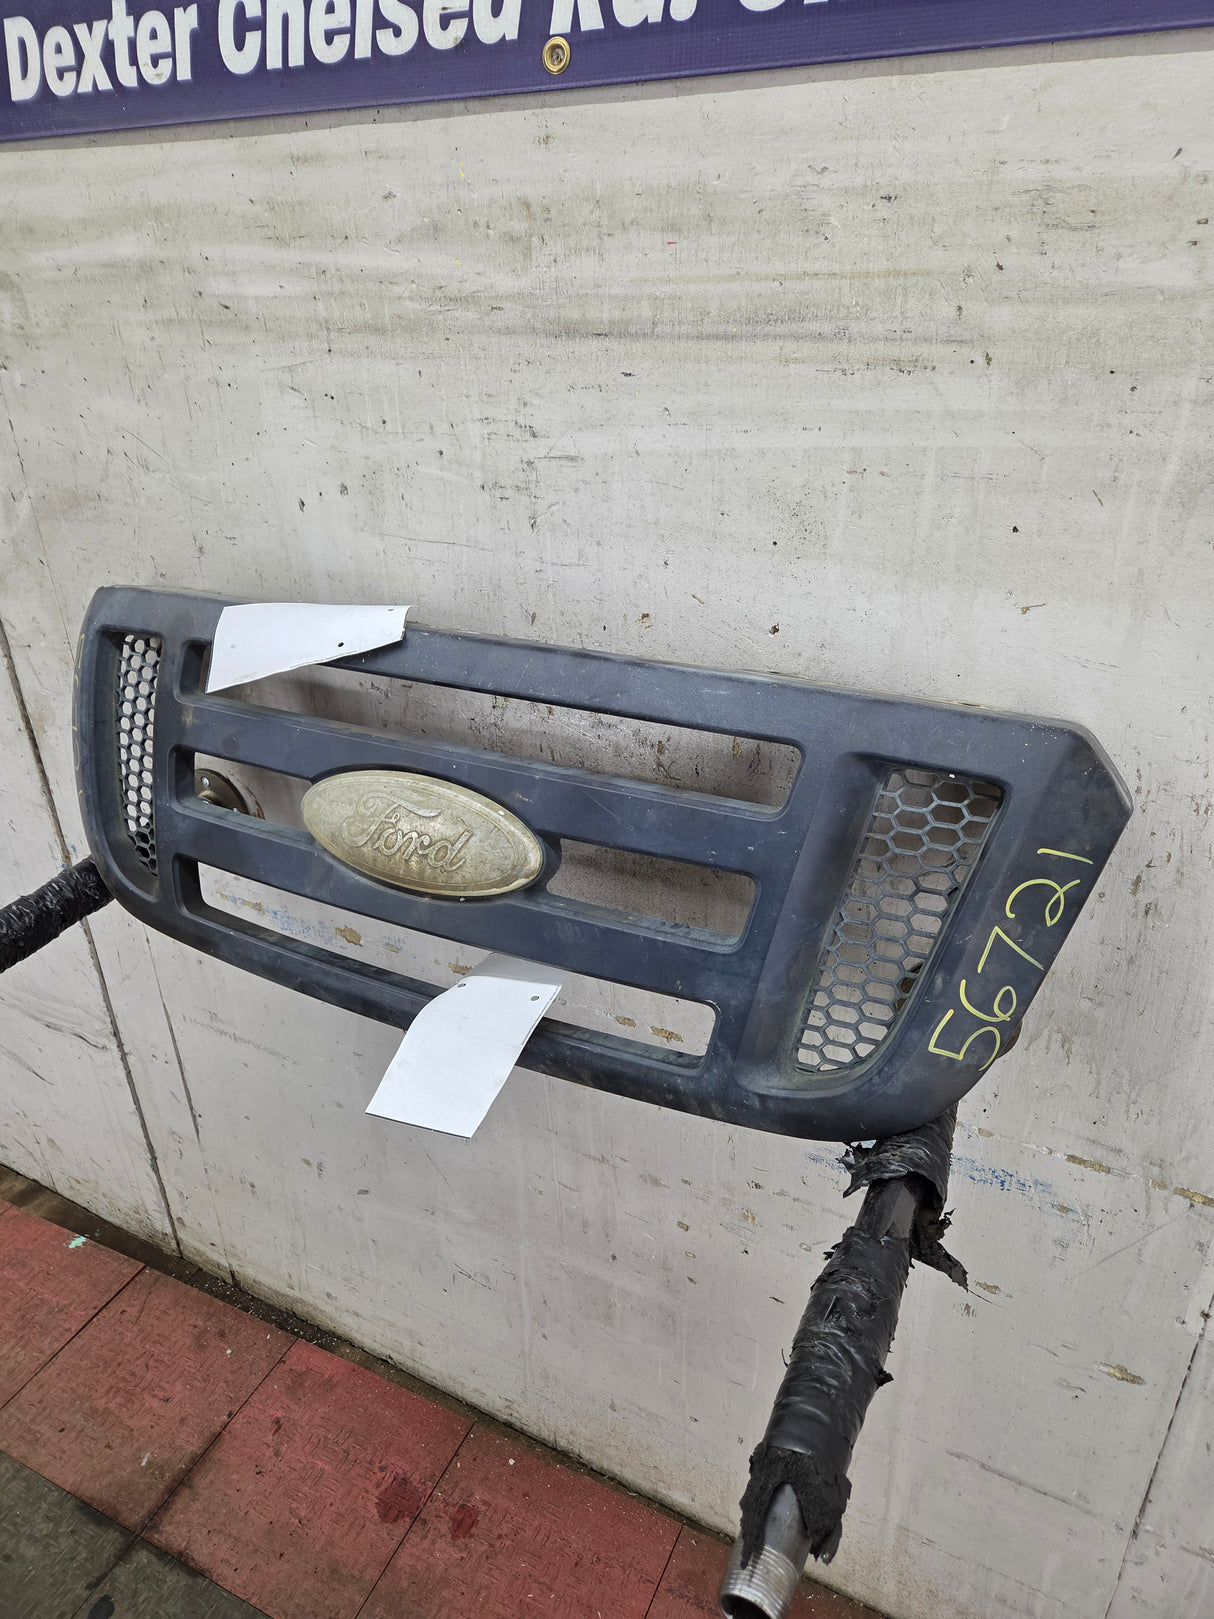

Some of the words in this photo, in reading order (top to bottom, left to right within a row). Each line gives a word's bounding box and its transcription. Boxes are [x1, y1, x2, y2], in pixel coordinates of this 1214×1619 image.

[3, 0, 198, 102] Dexter
[341, 791, 474, 872] Ford
[928, 847, 1094, 1072] 56721
